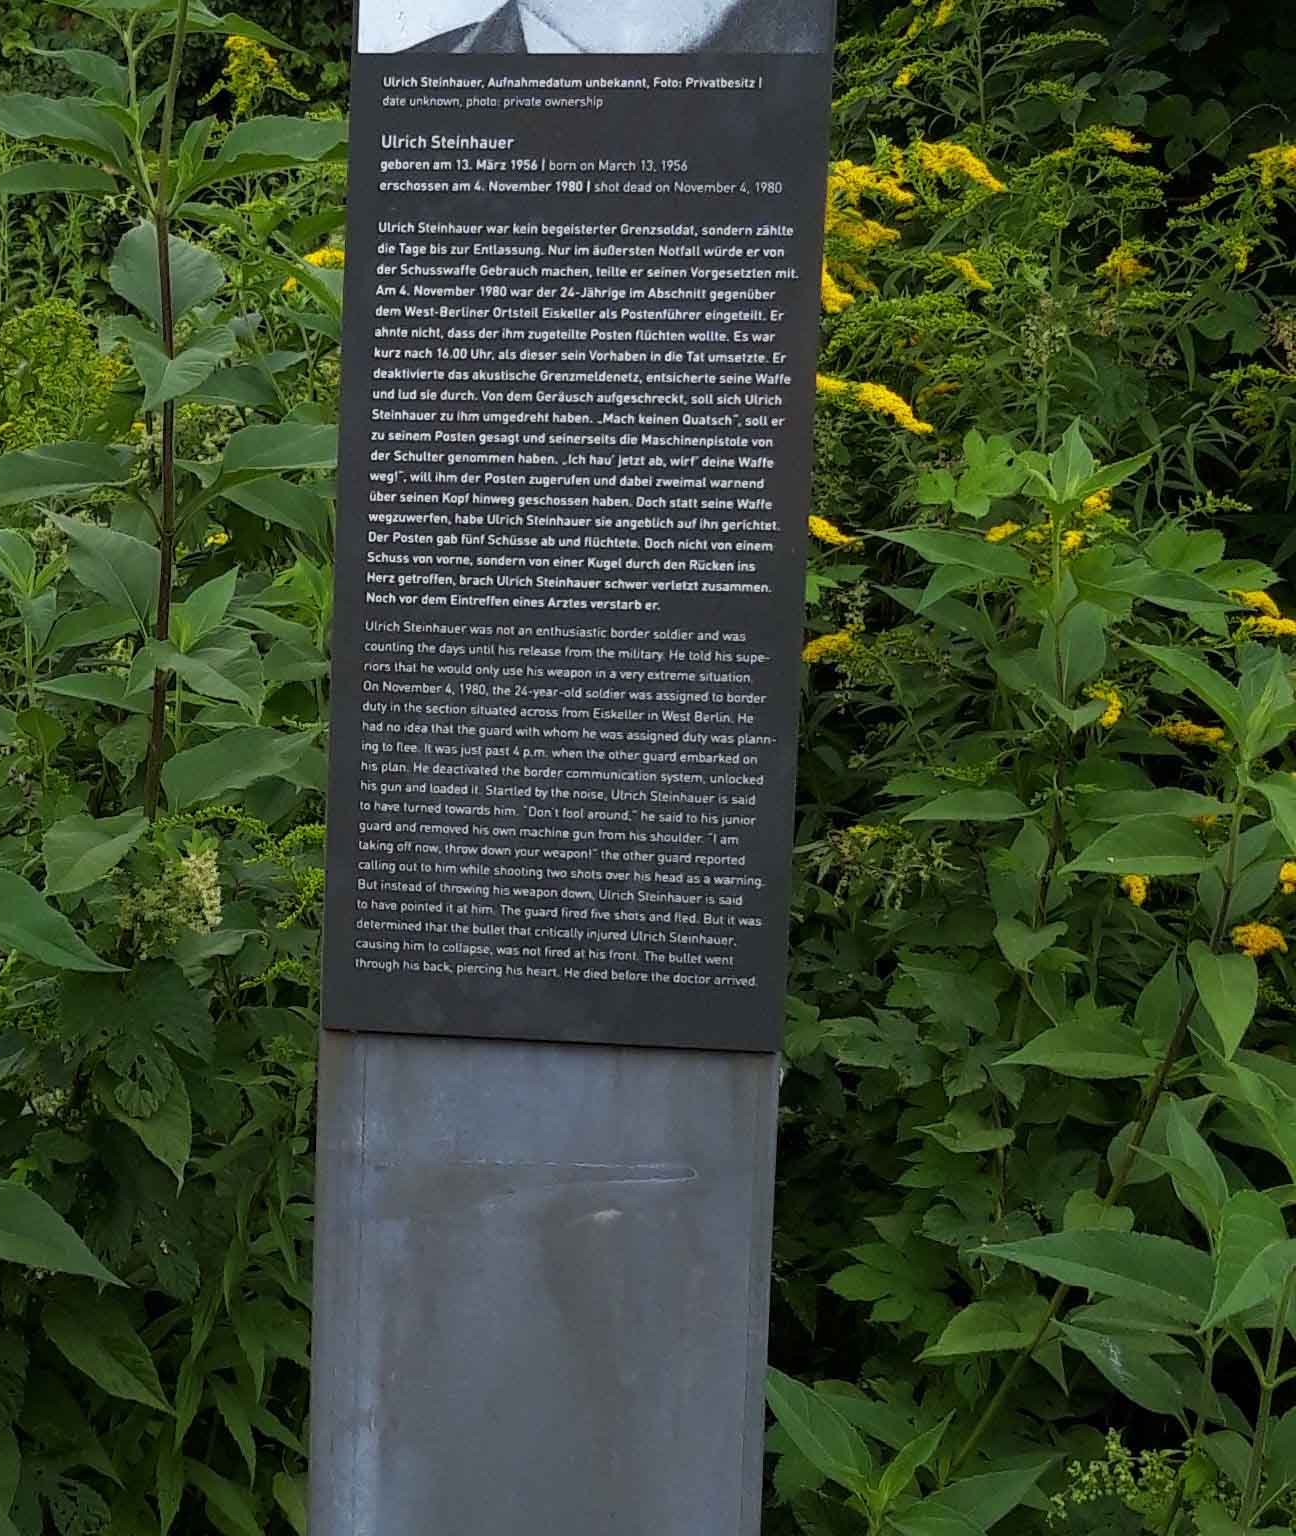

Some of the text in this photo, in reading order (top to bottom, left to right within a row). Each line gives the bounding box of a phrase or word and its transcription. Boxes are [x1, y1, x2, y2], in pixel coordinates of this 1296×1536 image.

[383, 77, 417, 86] Ulrich
[487, 77, 582, 87] Aufnahmedatum
[685, 77, 755, 87] Privatbesitz
[382, 96, 406, 105] date
[503, 96, 541, 108] private
[544, 96, 603, 108] ownership
[381, 135, 514, 148] Ulrich Steinhauer
[380, 159, 429, 172] geboren
[432, 161, 451, 169] am
[476, 159, 506, 169] März
[510, 159, 537, 169] 1956
[549, 160, 576, 170] born
[598, 160, 635, 170] March
[661, 160, 687, 170] 1956
[379, 180, 448, 191] erschossen
[488, 181, 552, 191] November
[555, 181, 583, 191] 1980
[594, 182, 619, 191] shot
[622, 182, 651, 192] dead
[655, 184, 669, 192] on
[674, 182, 736, 192] November
[755, 182, 782, 192] 1980
[378, 222, 414, 232] Ulrich
[418, 222, 483, 233] Steinhauer
[485, 225, 509, 233] war
[512, 223, 537, 233] kein
[541, 224, 617, 237] begeisterter
[701, 224, 752, 235] sondern
[755, 225, 793, 235] zählte
[377, 243, 395, 253] die
[398, 243, 426, 256] Tage
[429, 244, 447, 254] bis
[450, 246, 469, 254] zur
[547, 245, 570, 254] Nur
[574, 245, 589, 254] im
[592, 245, 654, 255] äußersten
[658, 245, 699, 256] Notfall
[703, 246, 742, 256] würde
[762, 249, 784, 257] von
[366, 592, 396, 602] Noch
[398, 595, 418, 603] vor
[421, 594, 446, 604] dem
[450, 594, 509, 606] Eintreffen
[512, 597, 544, 607] eines
[547, 597, 587, 608] Arztes
[590, 599, 642, 609] verstarb
[365, 621, 746, 641] Ulrich Steinhauer was not an enthusiastic border soldier and was
